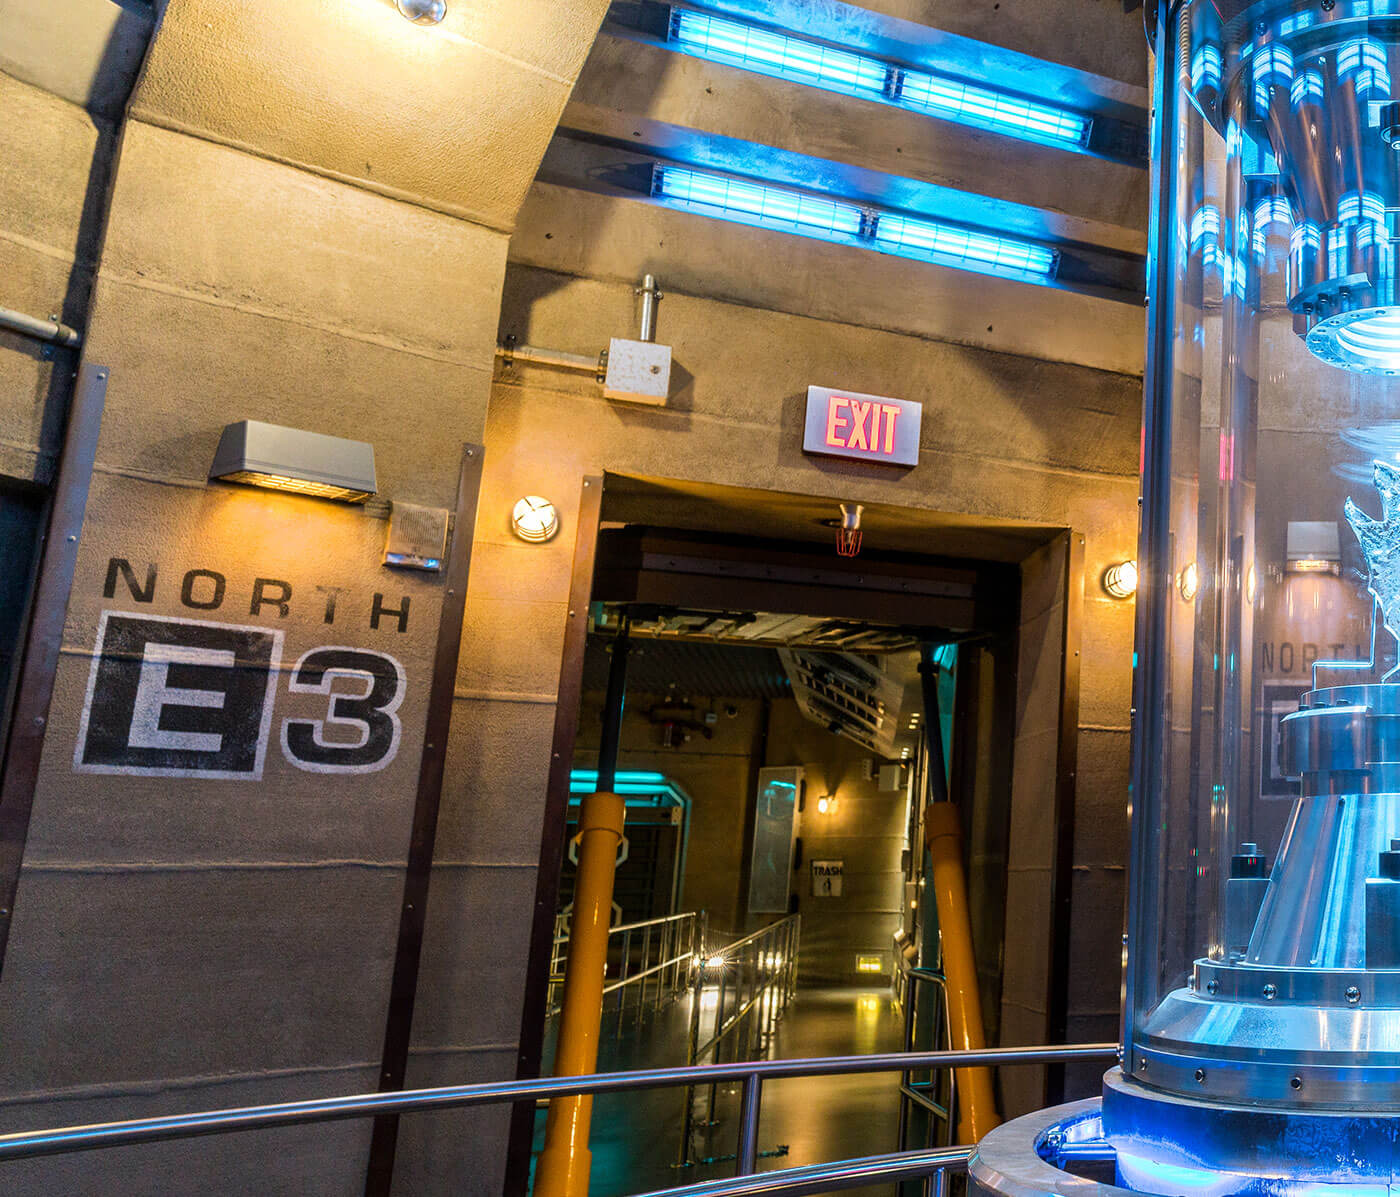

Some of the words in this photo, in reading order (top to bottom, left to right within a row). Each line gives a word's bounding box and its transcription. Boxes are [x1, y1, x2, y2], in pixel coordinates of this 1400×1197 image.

[826, 396, 901, 455] EXIT
[103, 557, 411, 633] NORTH
[814, 866, 842, 876] TRASH
